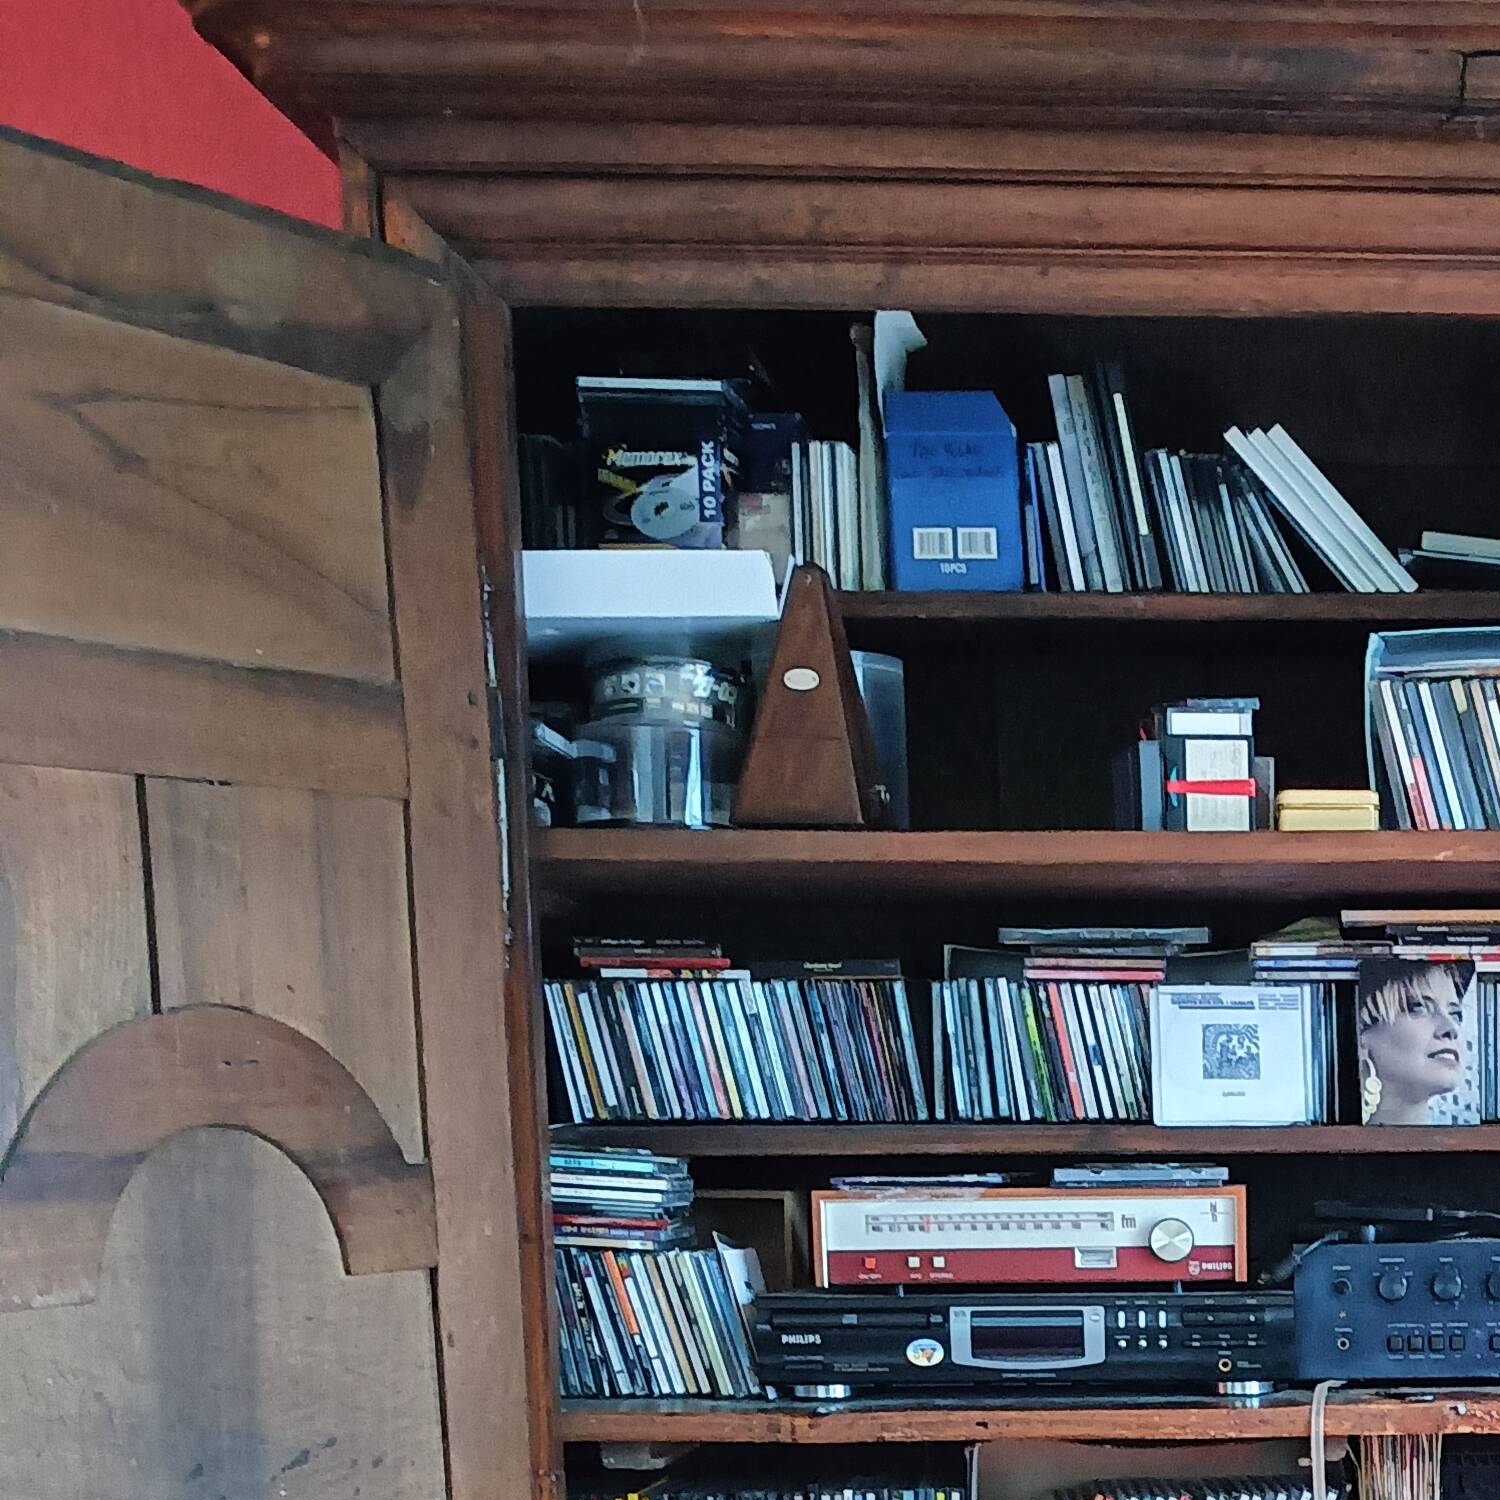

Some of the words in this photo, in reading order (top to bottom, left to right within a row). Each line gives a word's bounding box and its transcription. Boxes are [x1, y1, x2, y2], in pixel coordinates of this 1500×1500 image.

[701, 440, 716, 491] PACK
[703, 500, 717, 518] 10
[1121, 1214, 1137, 1229] fm
[1201, 1262, 1233, 1271] PHILIPS
[781, 1334, 821, 1345] PHILIPS
